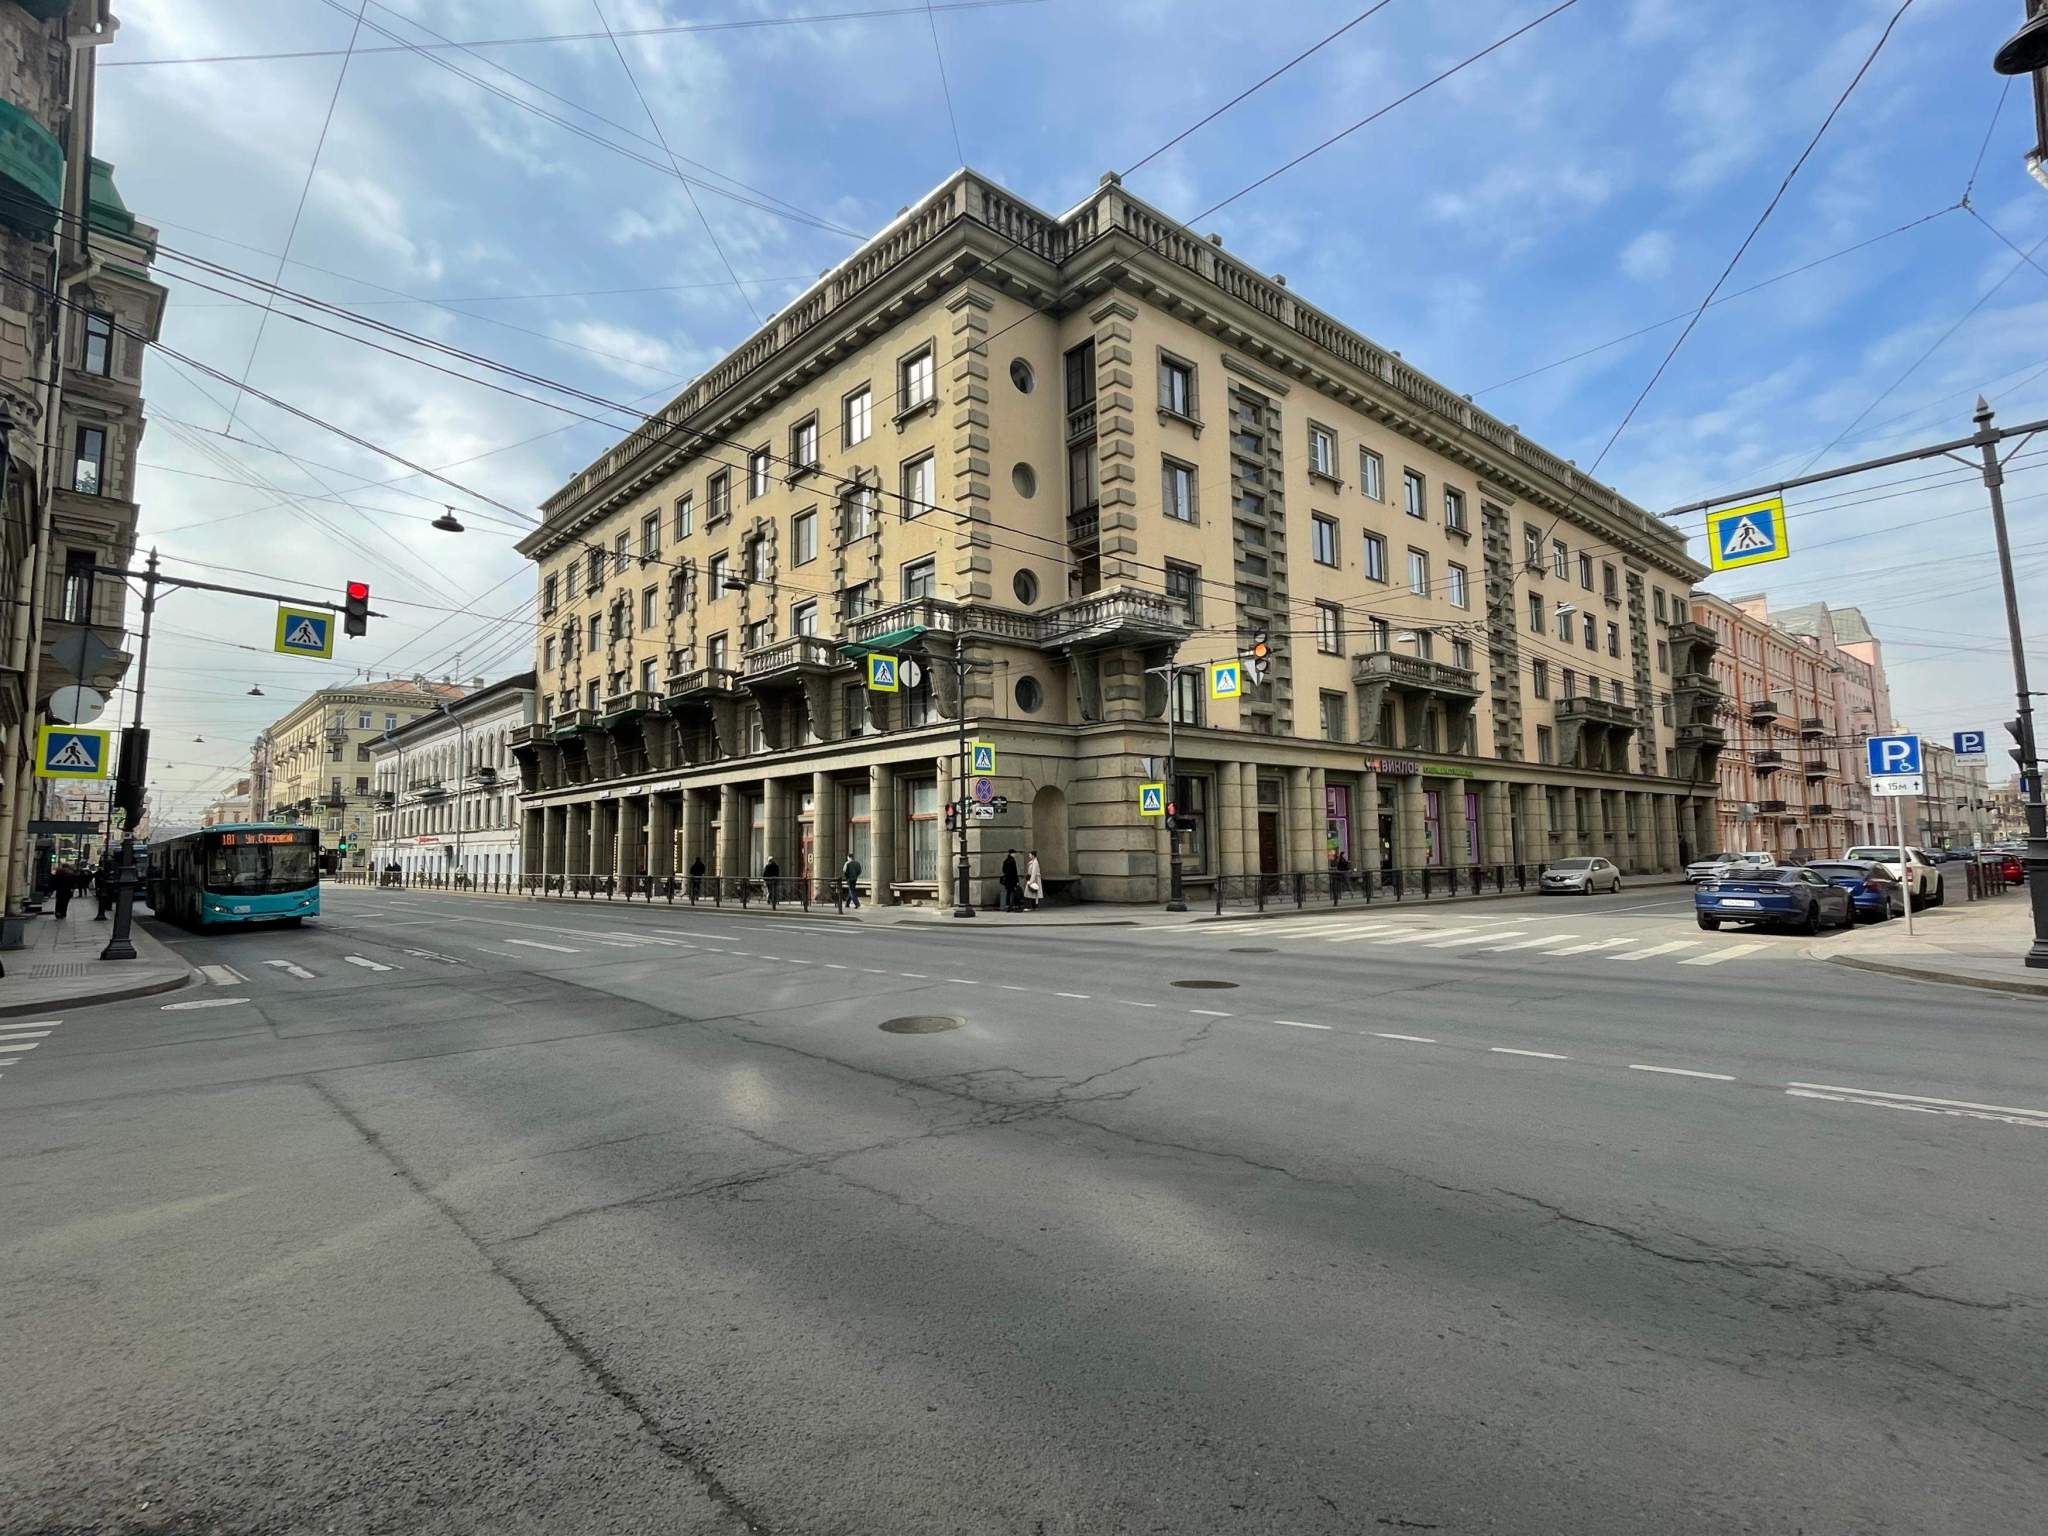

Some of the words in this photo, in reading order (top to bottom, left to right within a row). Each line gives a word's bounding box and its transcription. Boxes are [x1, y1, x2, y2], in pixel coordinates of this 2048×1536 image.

[1962, 733, 1980, 752] P
[1882, 740, 1911, 771] P
[222, 833, 236, 845] 181
